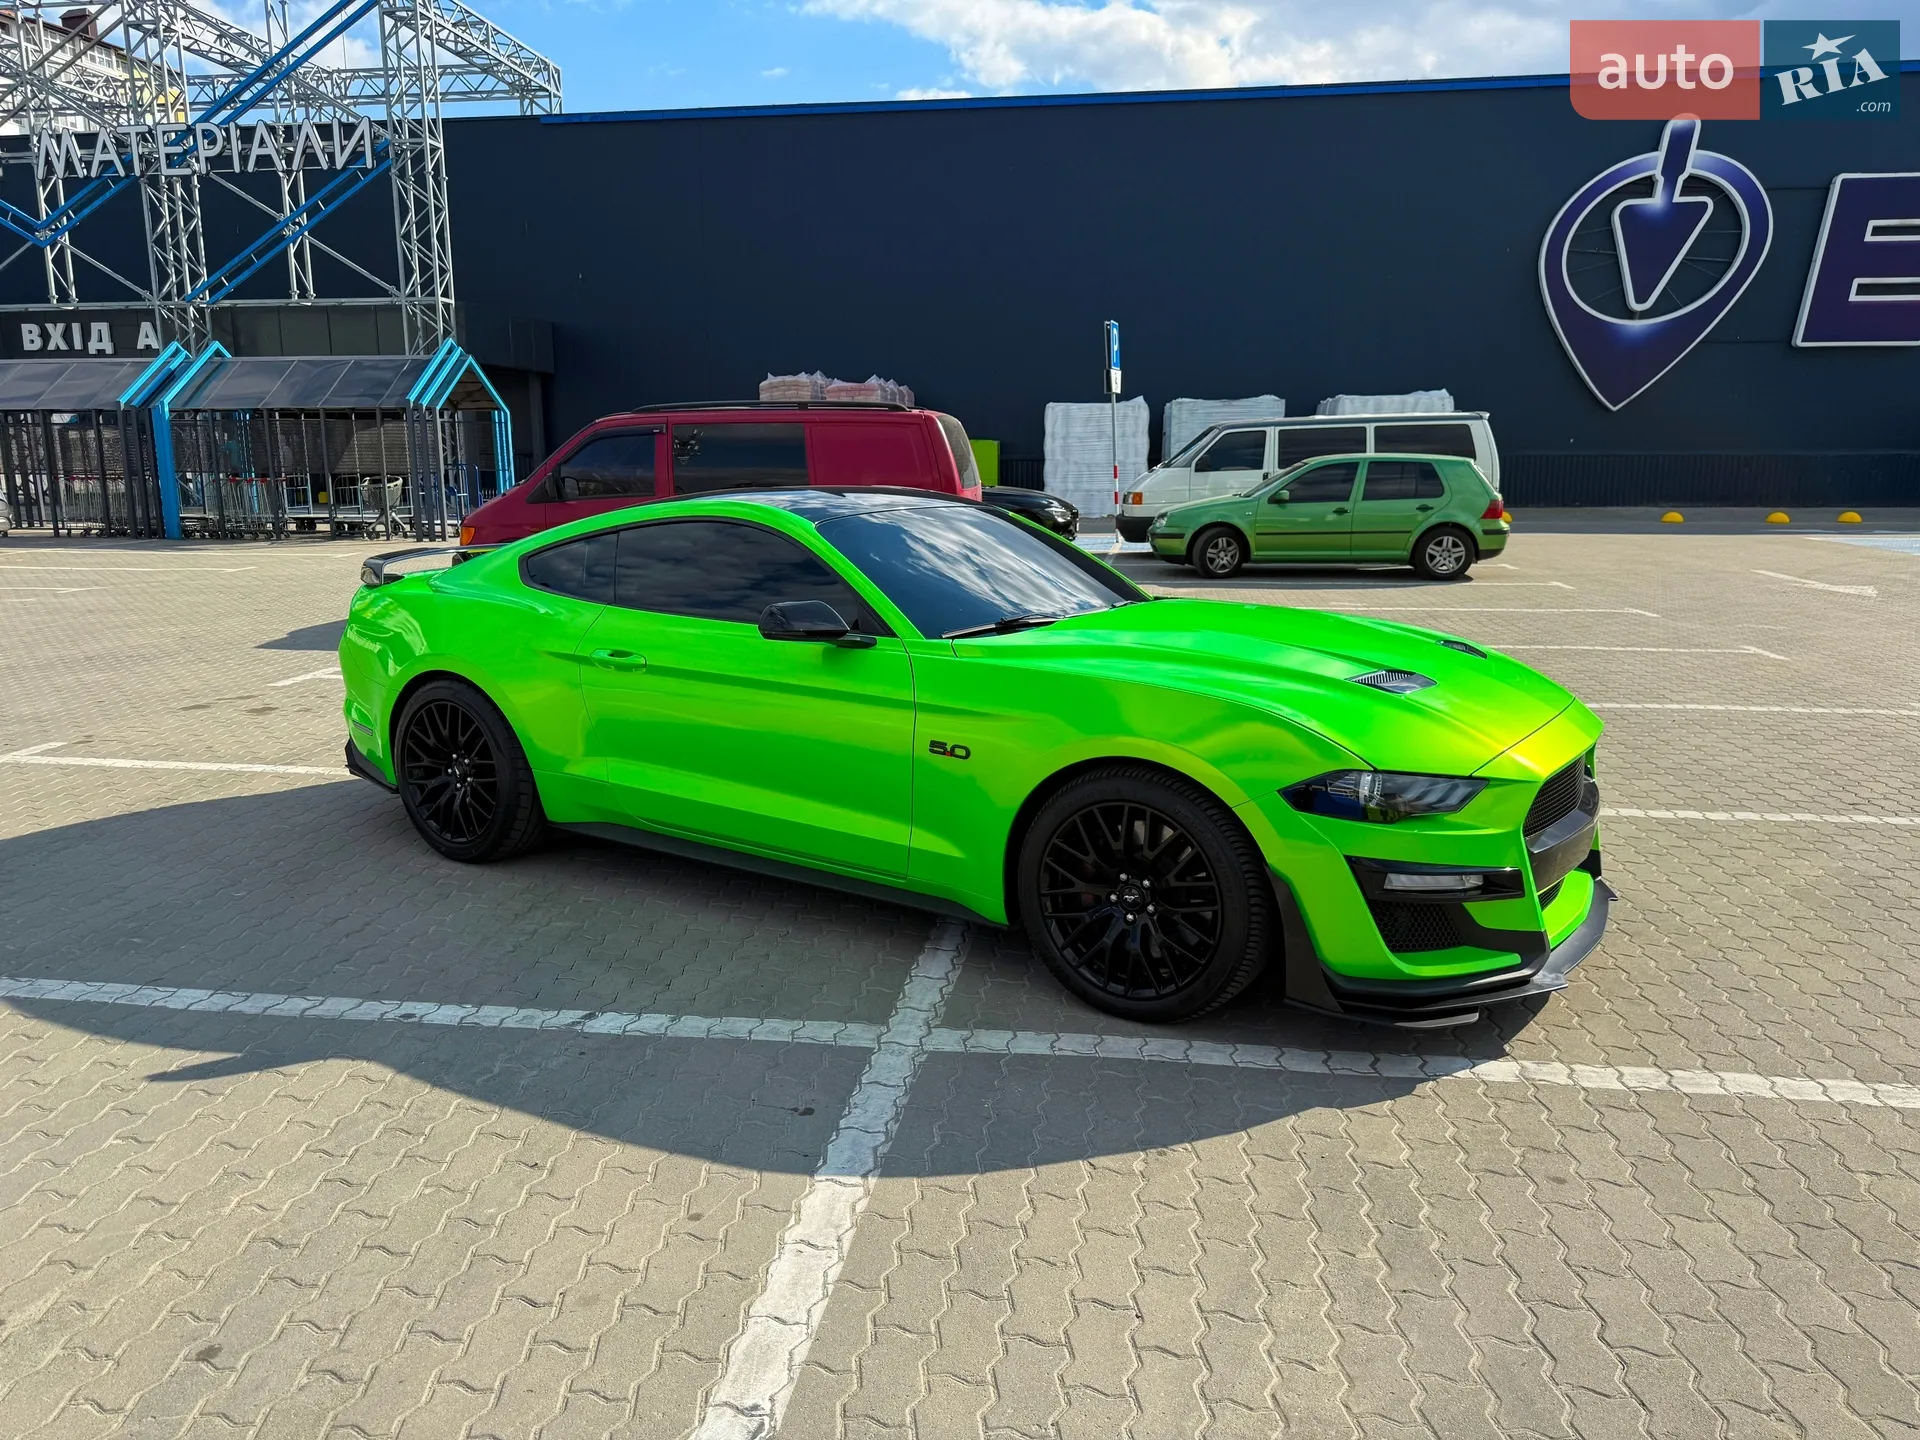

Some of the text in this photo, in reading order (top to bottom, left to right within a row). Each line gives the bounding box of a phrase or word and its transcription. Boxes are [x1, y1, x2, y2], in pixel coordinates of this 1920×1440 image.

[36, 115, 375, 180] МАТЕРІАЛИ
[20, 321, 161, 355] ВХІД А
[1113, 327, 1119, 363] P
[929, 739, 971, 760] 5.0
